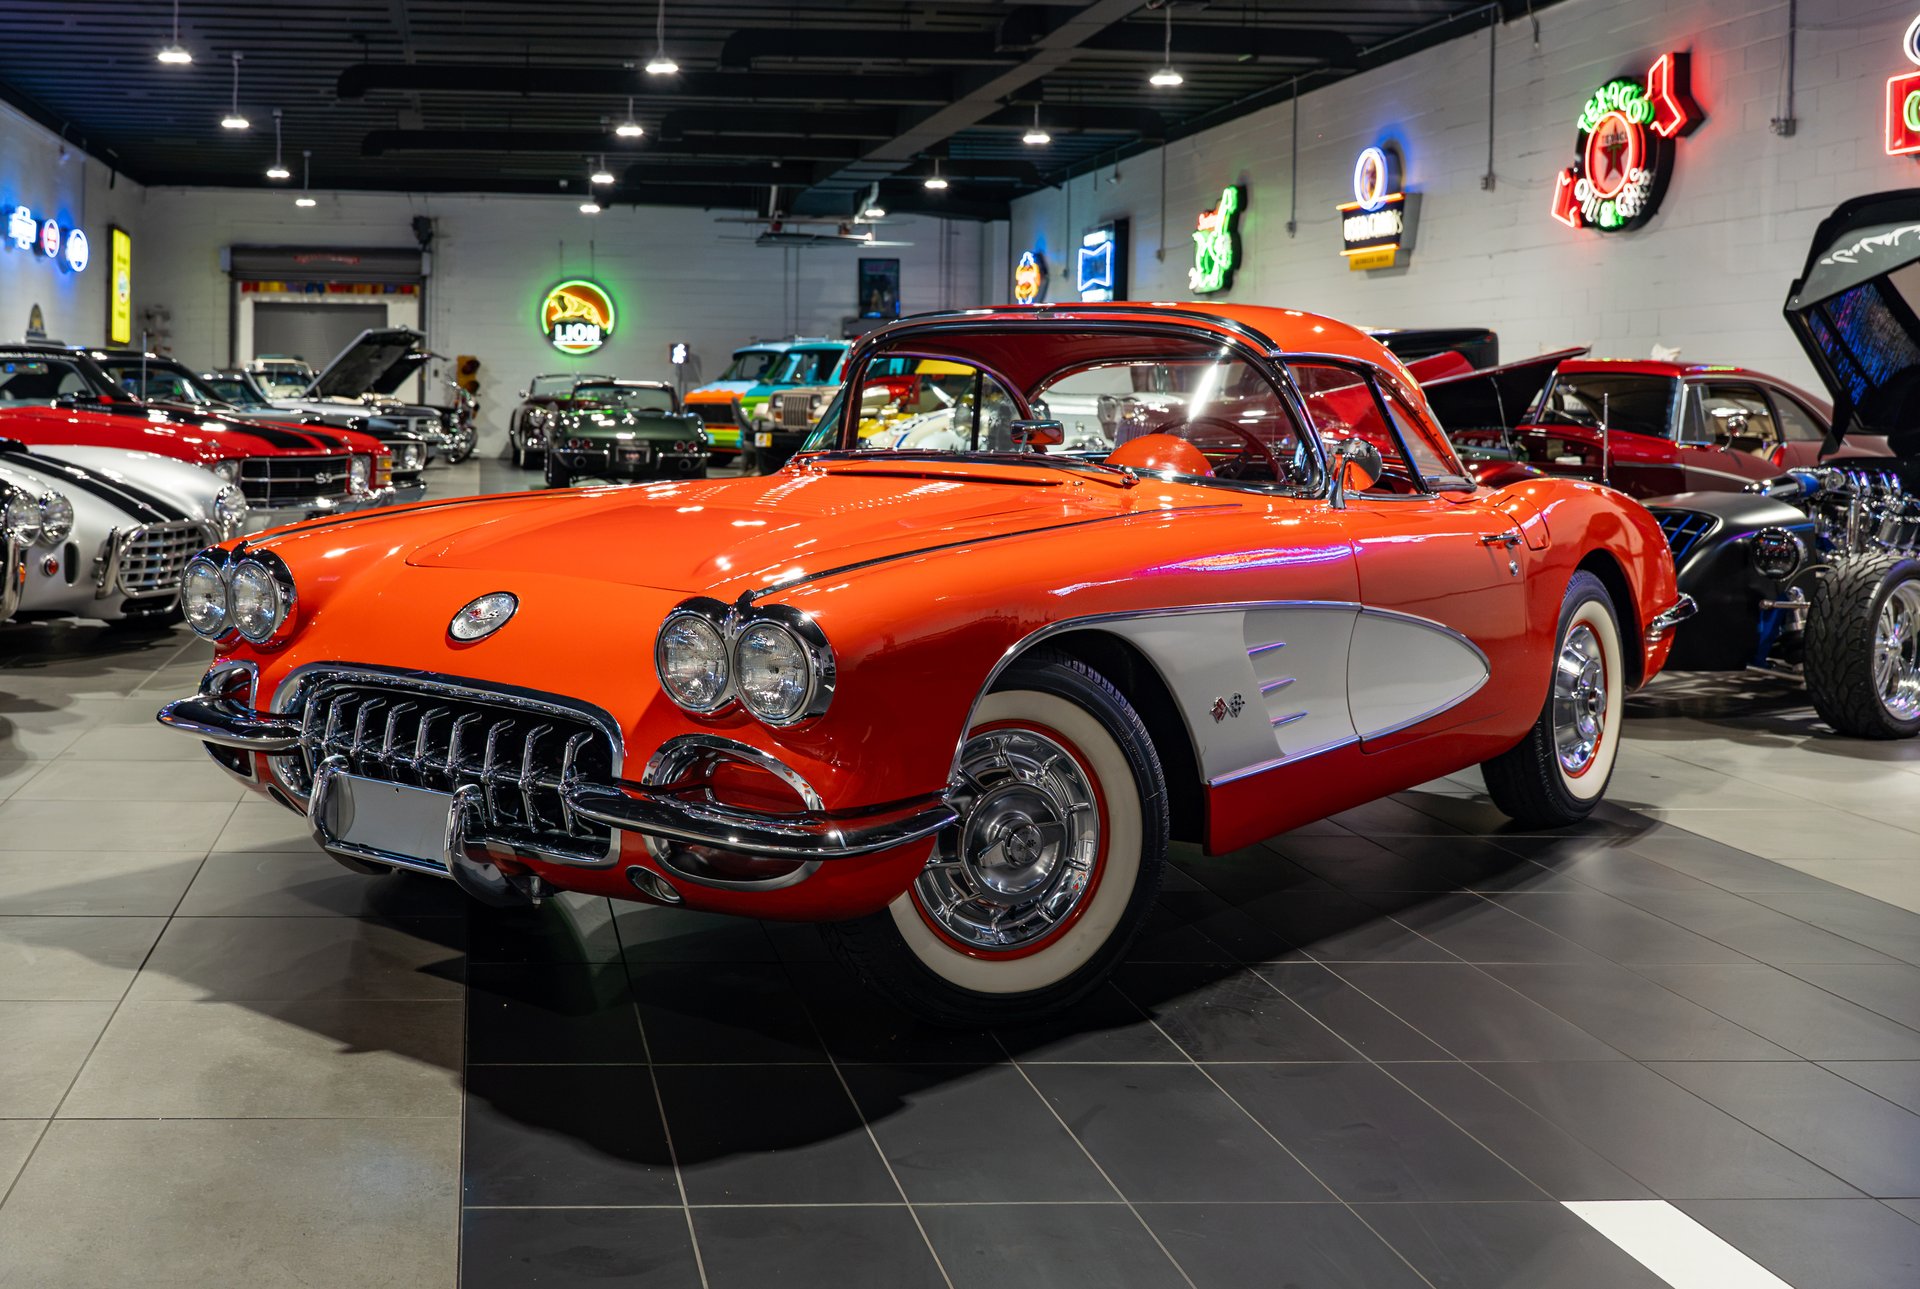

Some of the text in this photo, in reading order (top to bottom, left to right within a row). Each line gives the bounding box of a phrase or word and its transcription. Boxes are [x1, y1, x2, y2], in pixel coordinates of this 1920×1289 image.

[1577, 81, 1643, 133] TEXACO
[1574, 178, 1595, 222] OIL
[1615, 168, 1647, 217] GAS
[555, 323, 600, 341] LION
[315, 472, 333, 484] SS
